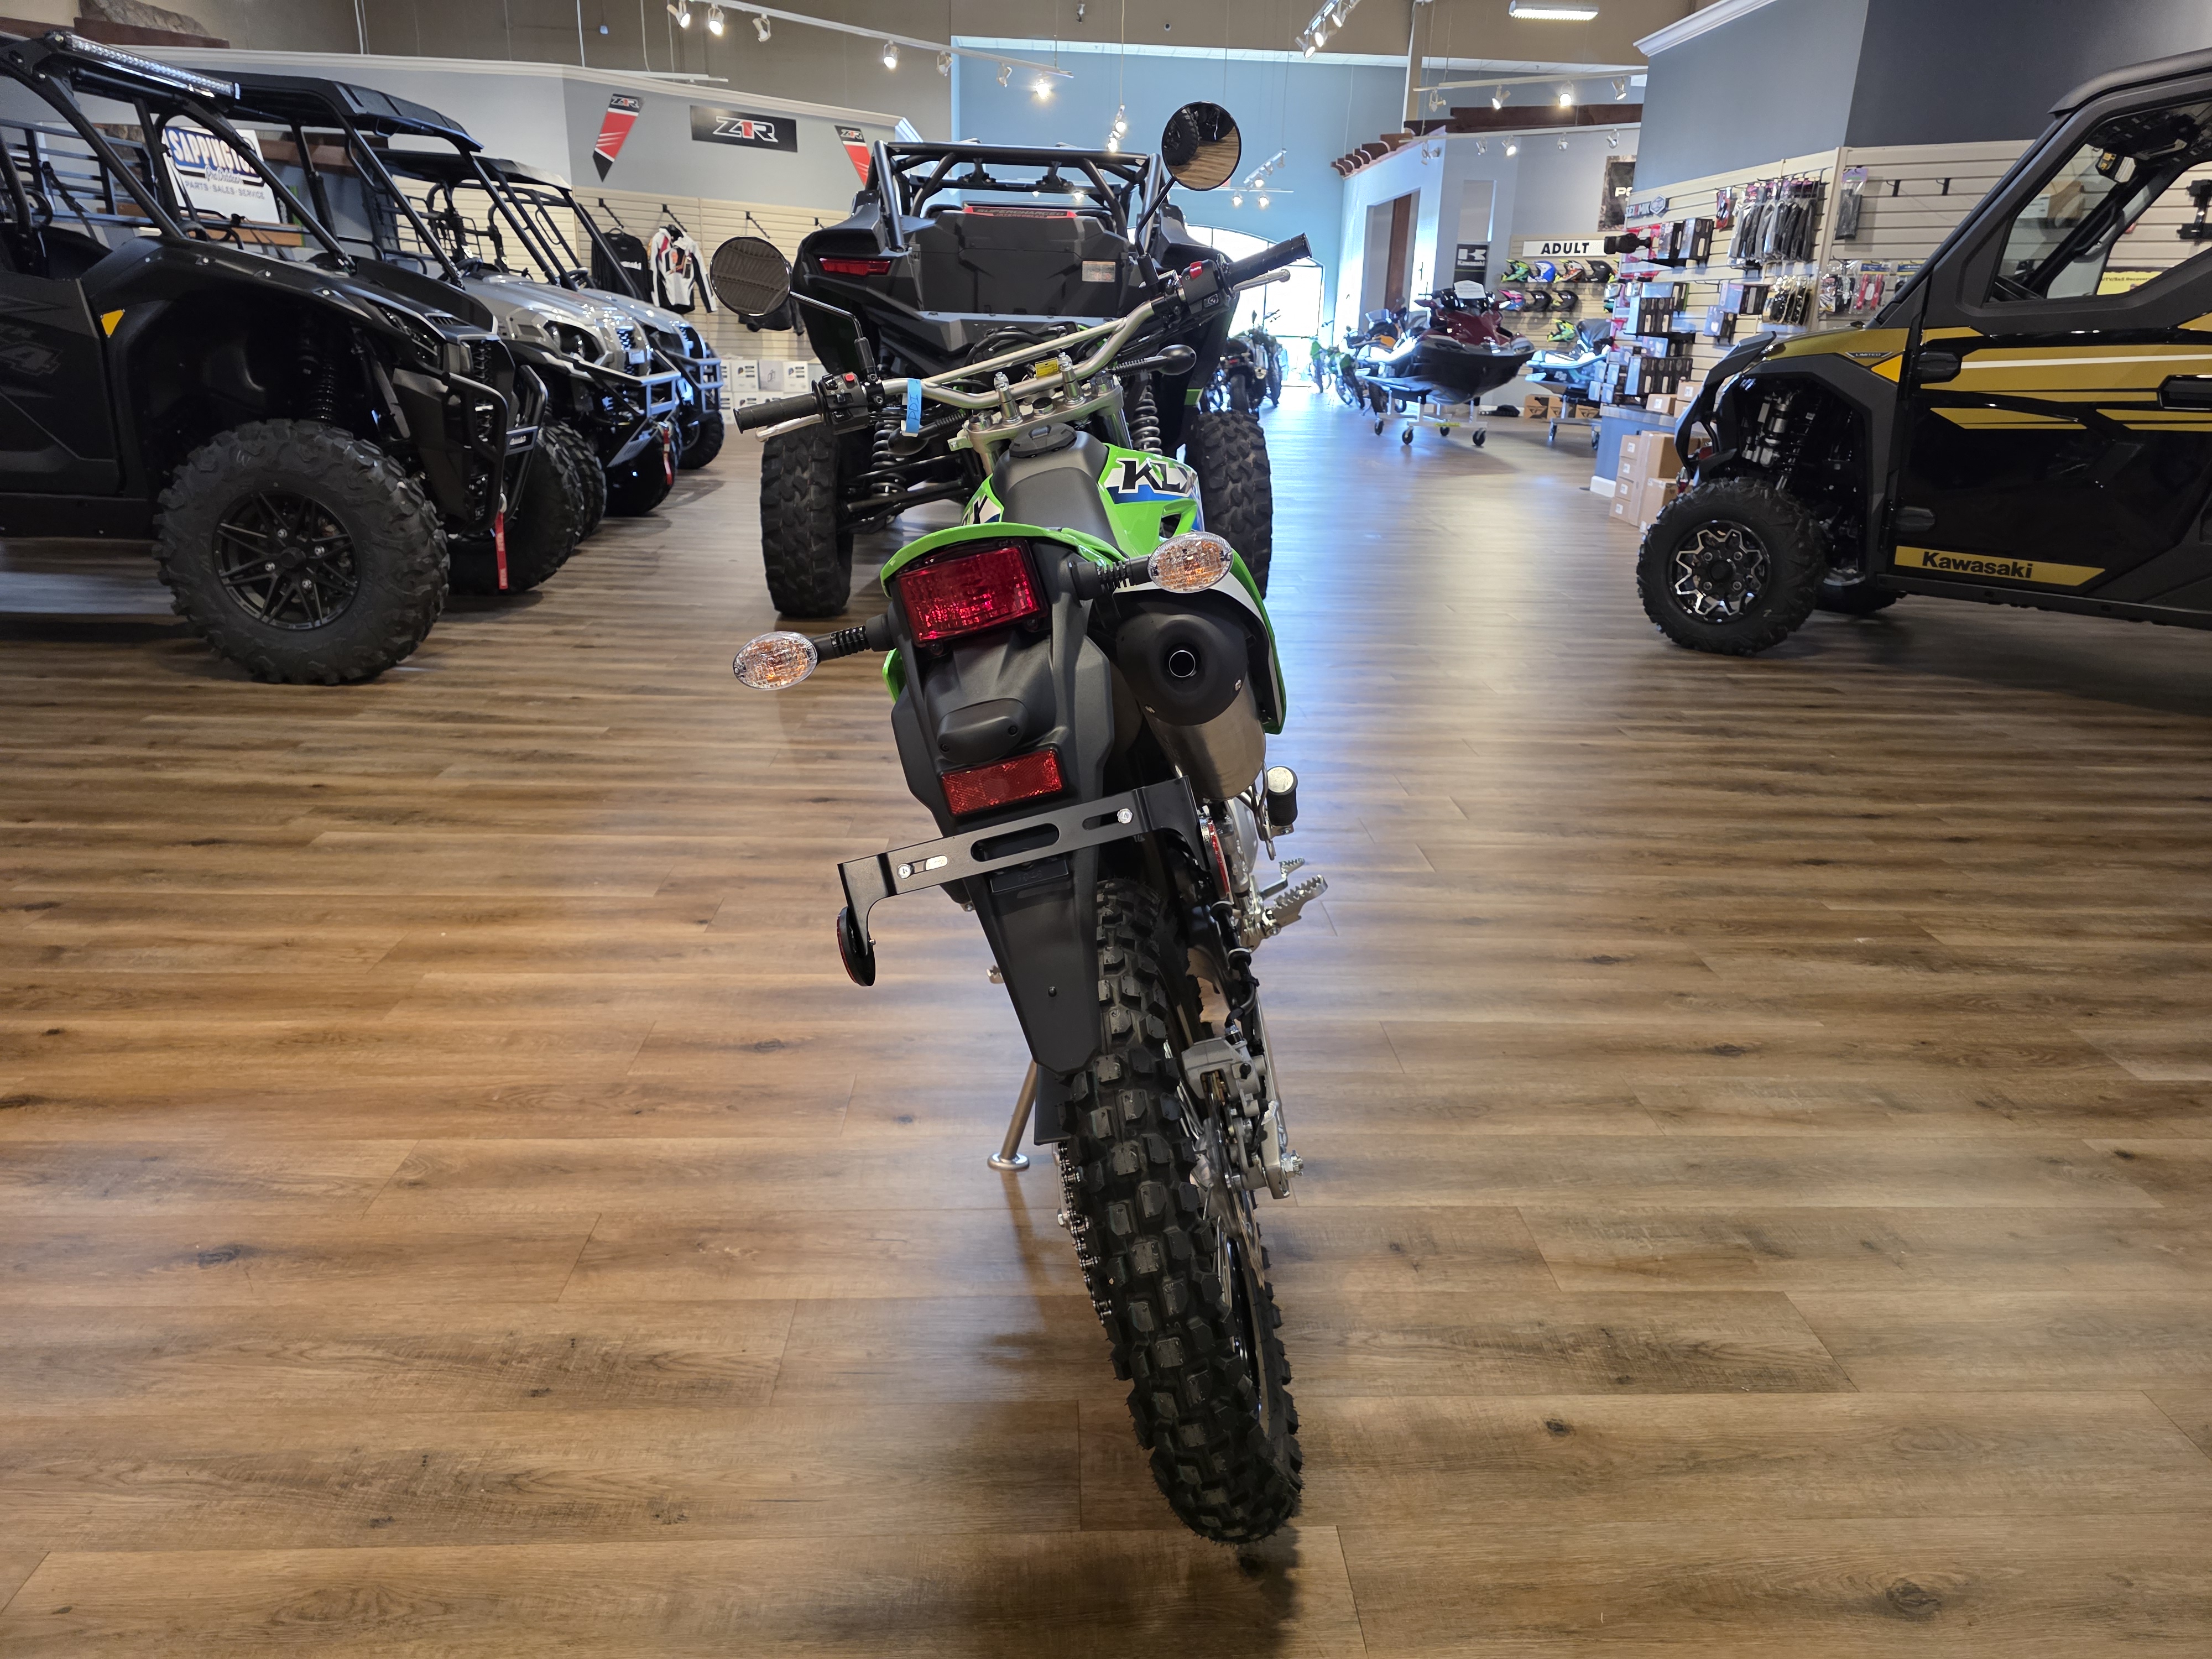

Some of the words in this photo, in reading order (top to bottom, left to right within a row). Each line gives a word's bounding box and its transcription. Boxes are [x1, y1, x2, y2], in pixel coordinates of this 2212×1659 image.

[168, 130, 257, 175] SAPPINGTO
[1541, 242, 1589, 254] ADULT
[908, 392, 919, 421] PDI
[1922, 551, 2033, 578] Kawasaki
